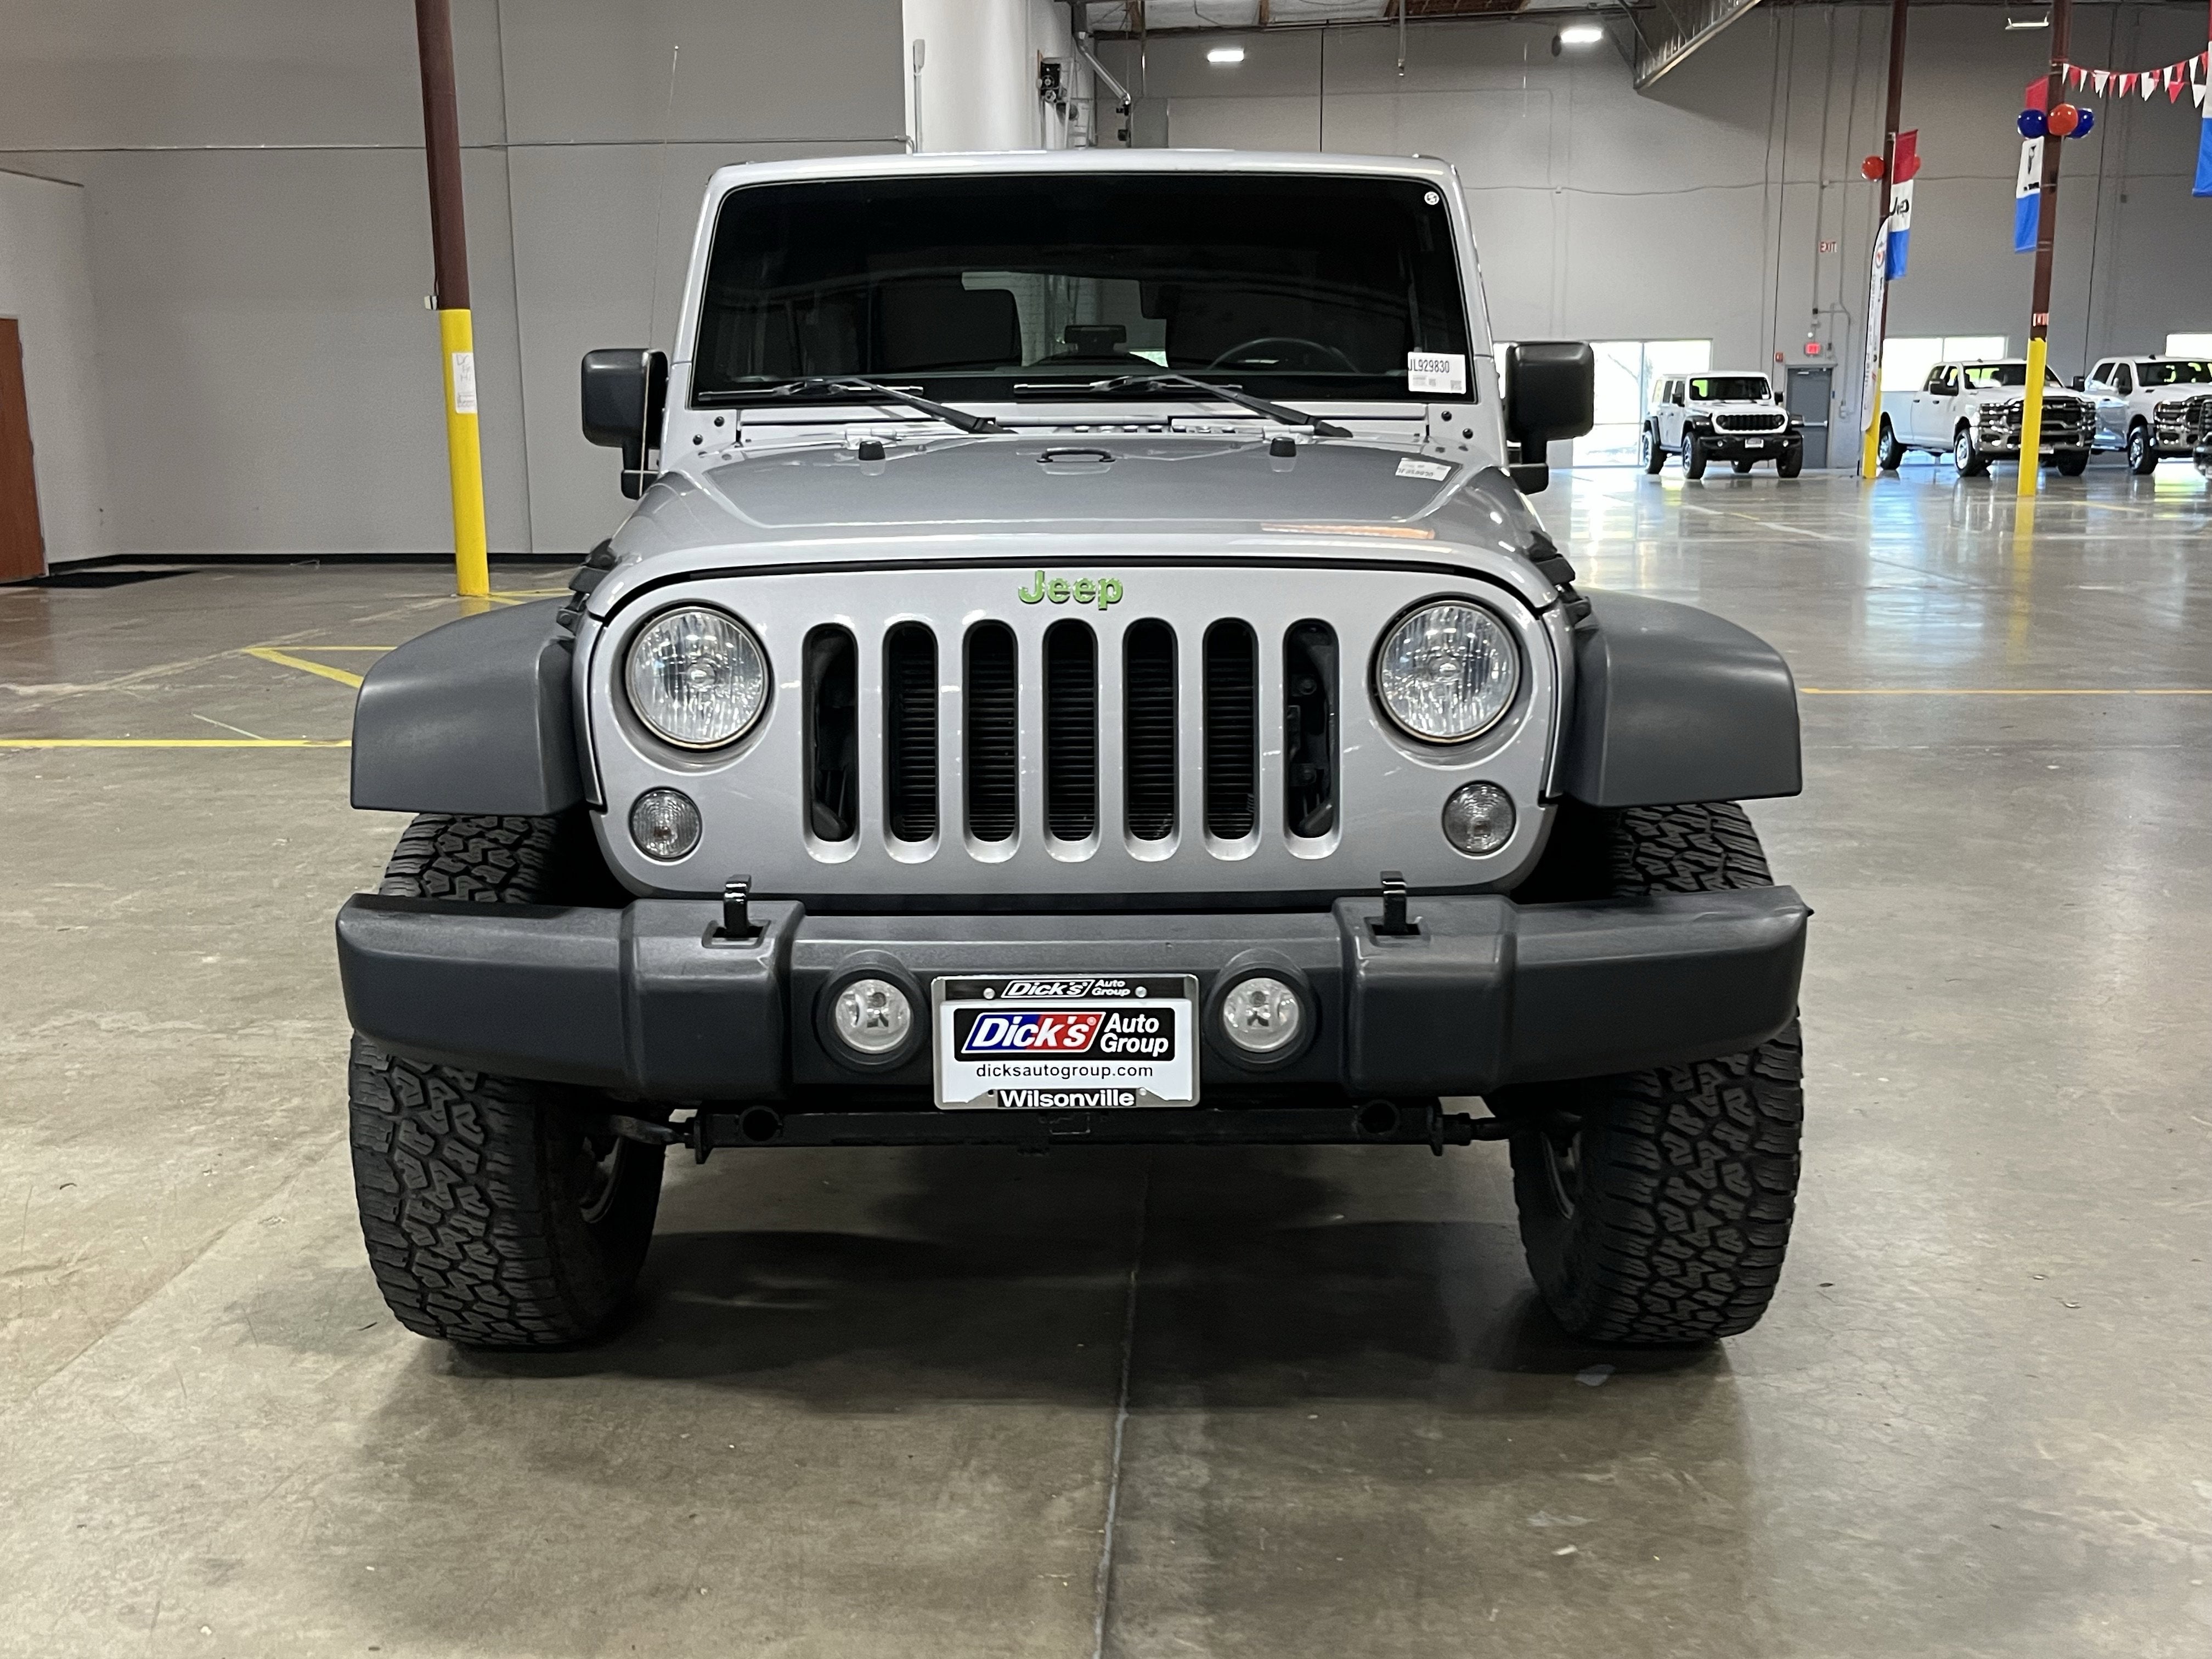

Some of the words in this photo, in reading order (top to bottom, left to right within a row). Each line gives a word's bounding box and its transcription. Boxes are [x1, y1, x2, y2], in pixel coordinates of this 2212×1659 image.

[1820, 241, 1836, 252] EXIT
[1408, 359, 1449, 373] JL929830
[1018, 570, 1123, 611] Jeep
[1007, 981, 1084, 996] Dick's
[1095, 979, 1126, 988] Auto
[1092, 987, 1130, 997] Group
[972, 1015, 1090, 1047] Dick's
[1104, 1013, 1159, 1033] Auto
[1100, 1032, 1169, 1057] Group
[976, 1064, 1153, 1079] dicksautogroup.com
[1000, 1088, 1135, 1108] Wilsonville
